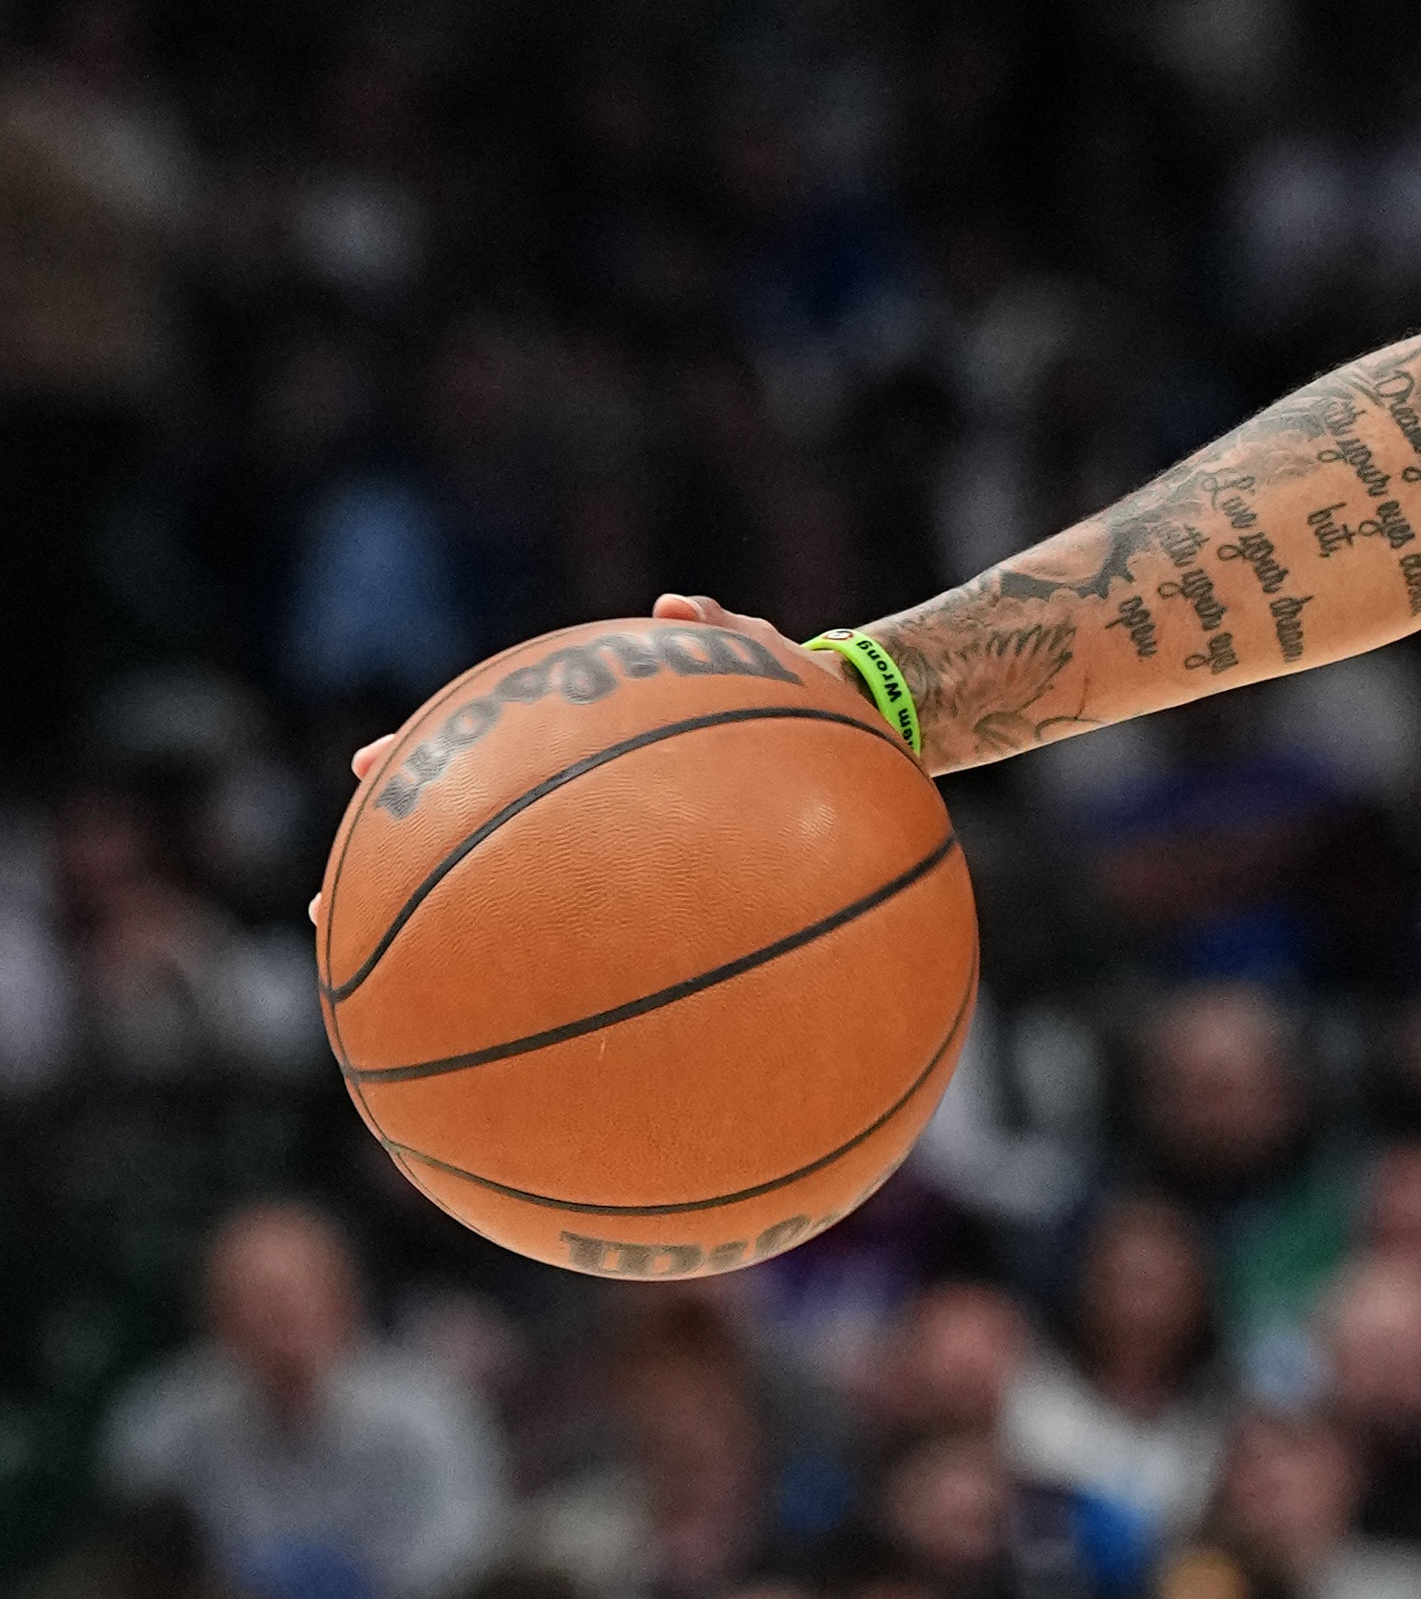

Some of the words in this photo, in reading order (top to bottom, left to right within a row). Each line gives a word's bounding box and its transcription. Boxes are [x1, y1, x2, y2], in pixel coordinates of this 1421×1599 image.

[1317, 437, 1391, 498] your
[1358, 500, 1416, 549] eyes
[1217, 531, 1289, 594] your
[1157, 567, 1229, 632] your
[855, 639, 903, 703] Wrong
